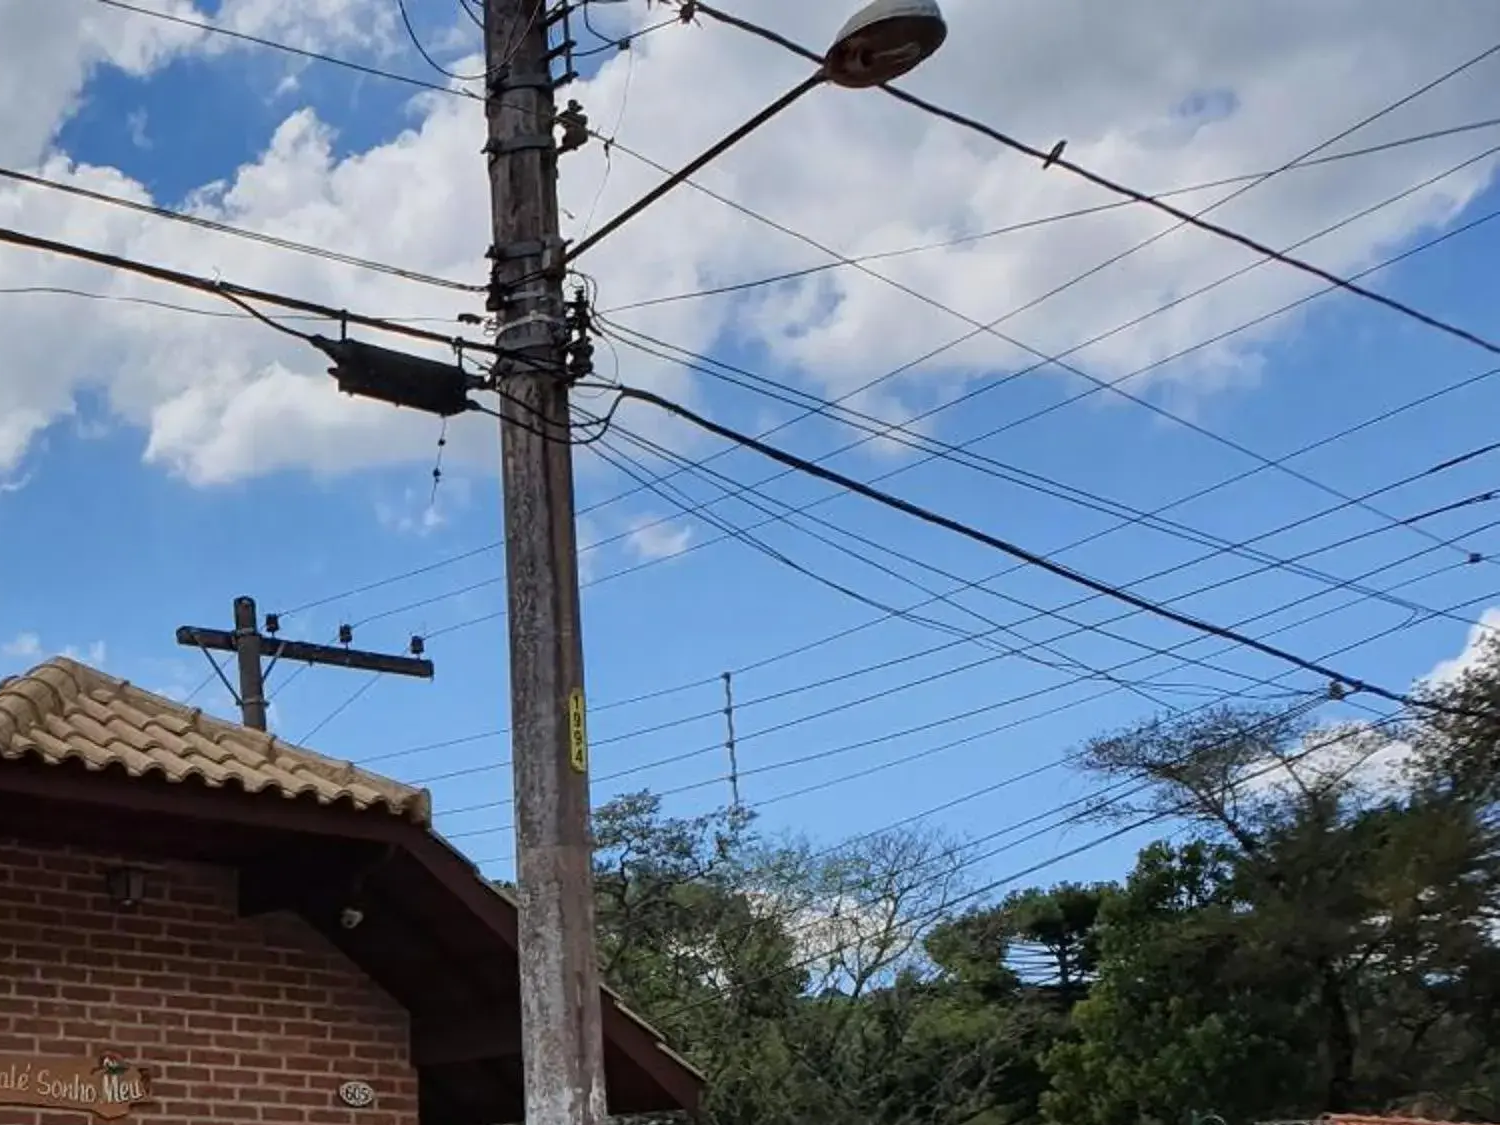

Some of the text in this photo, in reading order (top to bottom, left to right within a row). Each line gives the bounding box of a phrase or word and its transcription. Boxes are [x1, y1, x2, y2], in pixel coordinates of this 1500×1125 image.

[573, 695, 583, 763] 1994
[37, 1069, 97, 1102] Sonho
[103, 1074, 144, 1104] Meu
[345, 1085, 370, 1101] 605
